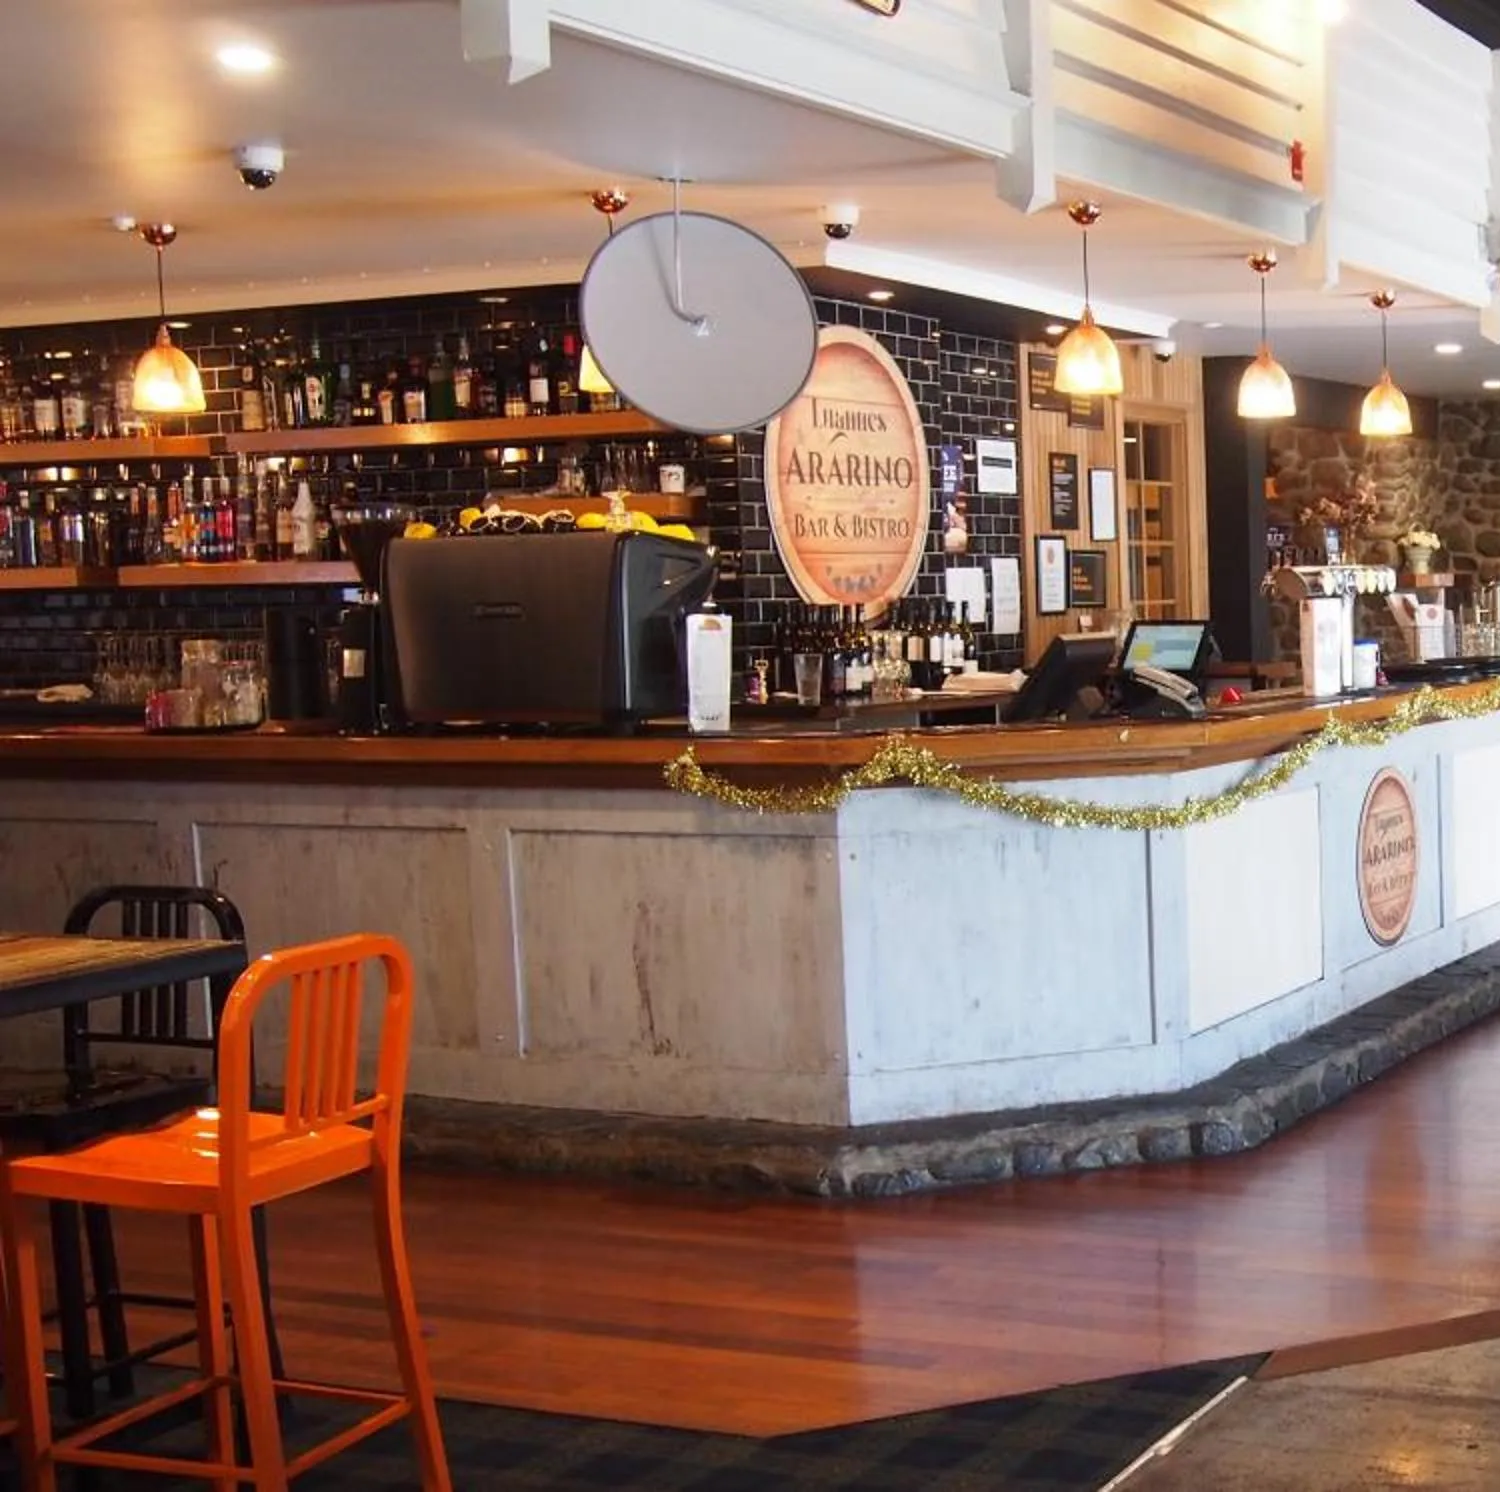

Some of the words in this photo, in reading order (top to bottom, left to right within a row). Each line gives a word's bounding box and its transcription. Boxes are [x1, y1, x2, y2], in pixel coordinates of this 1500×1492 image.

[785, 447, 913, 489] ARARINO
[794, 513, 829, 537] BAR
[833, 514, 847, 537] &
[852, 514, 909, 538] BISTRO
